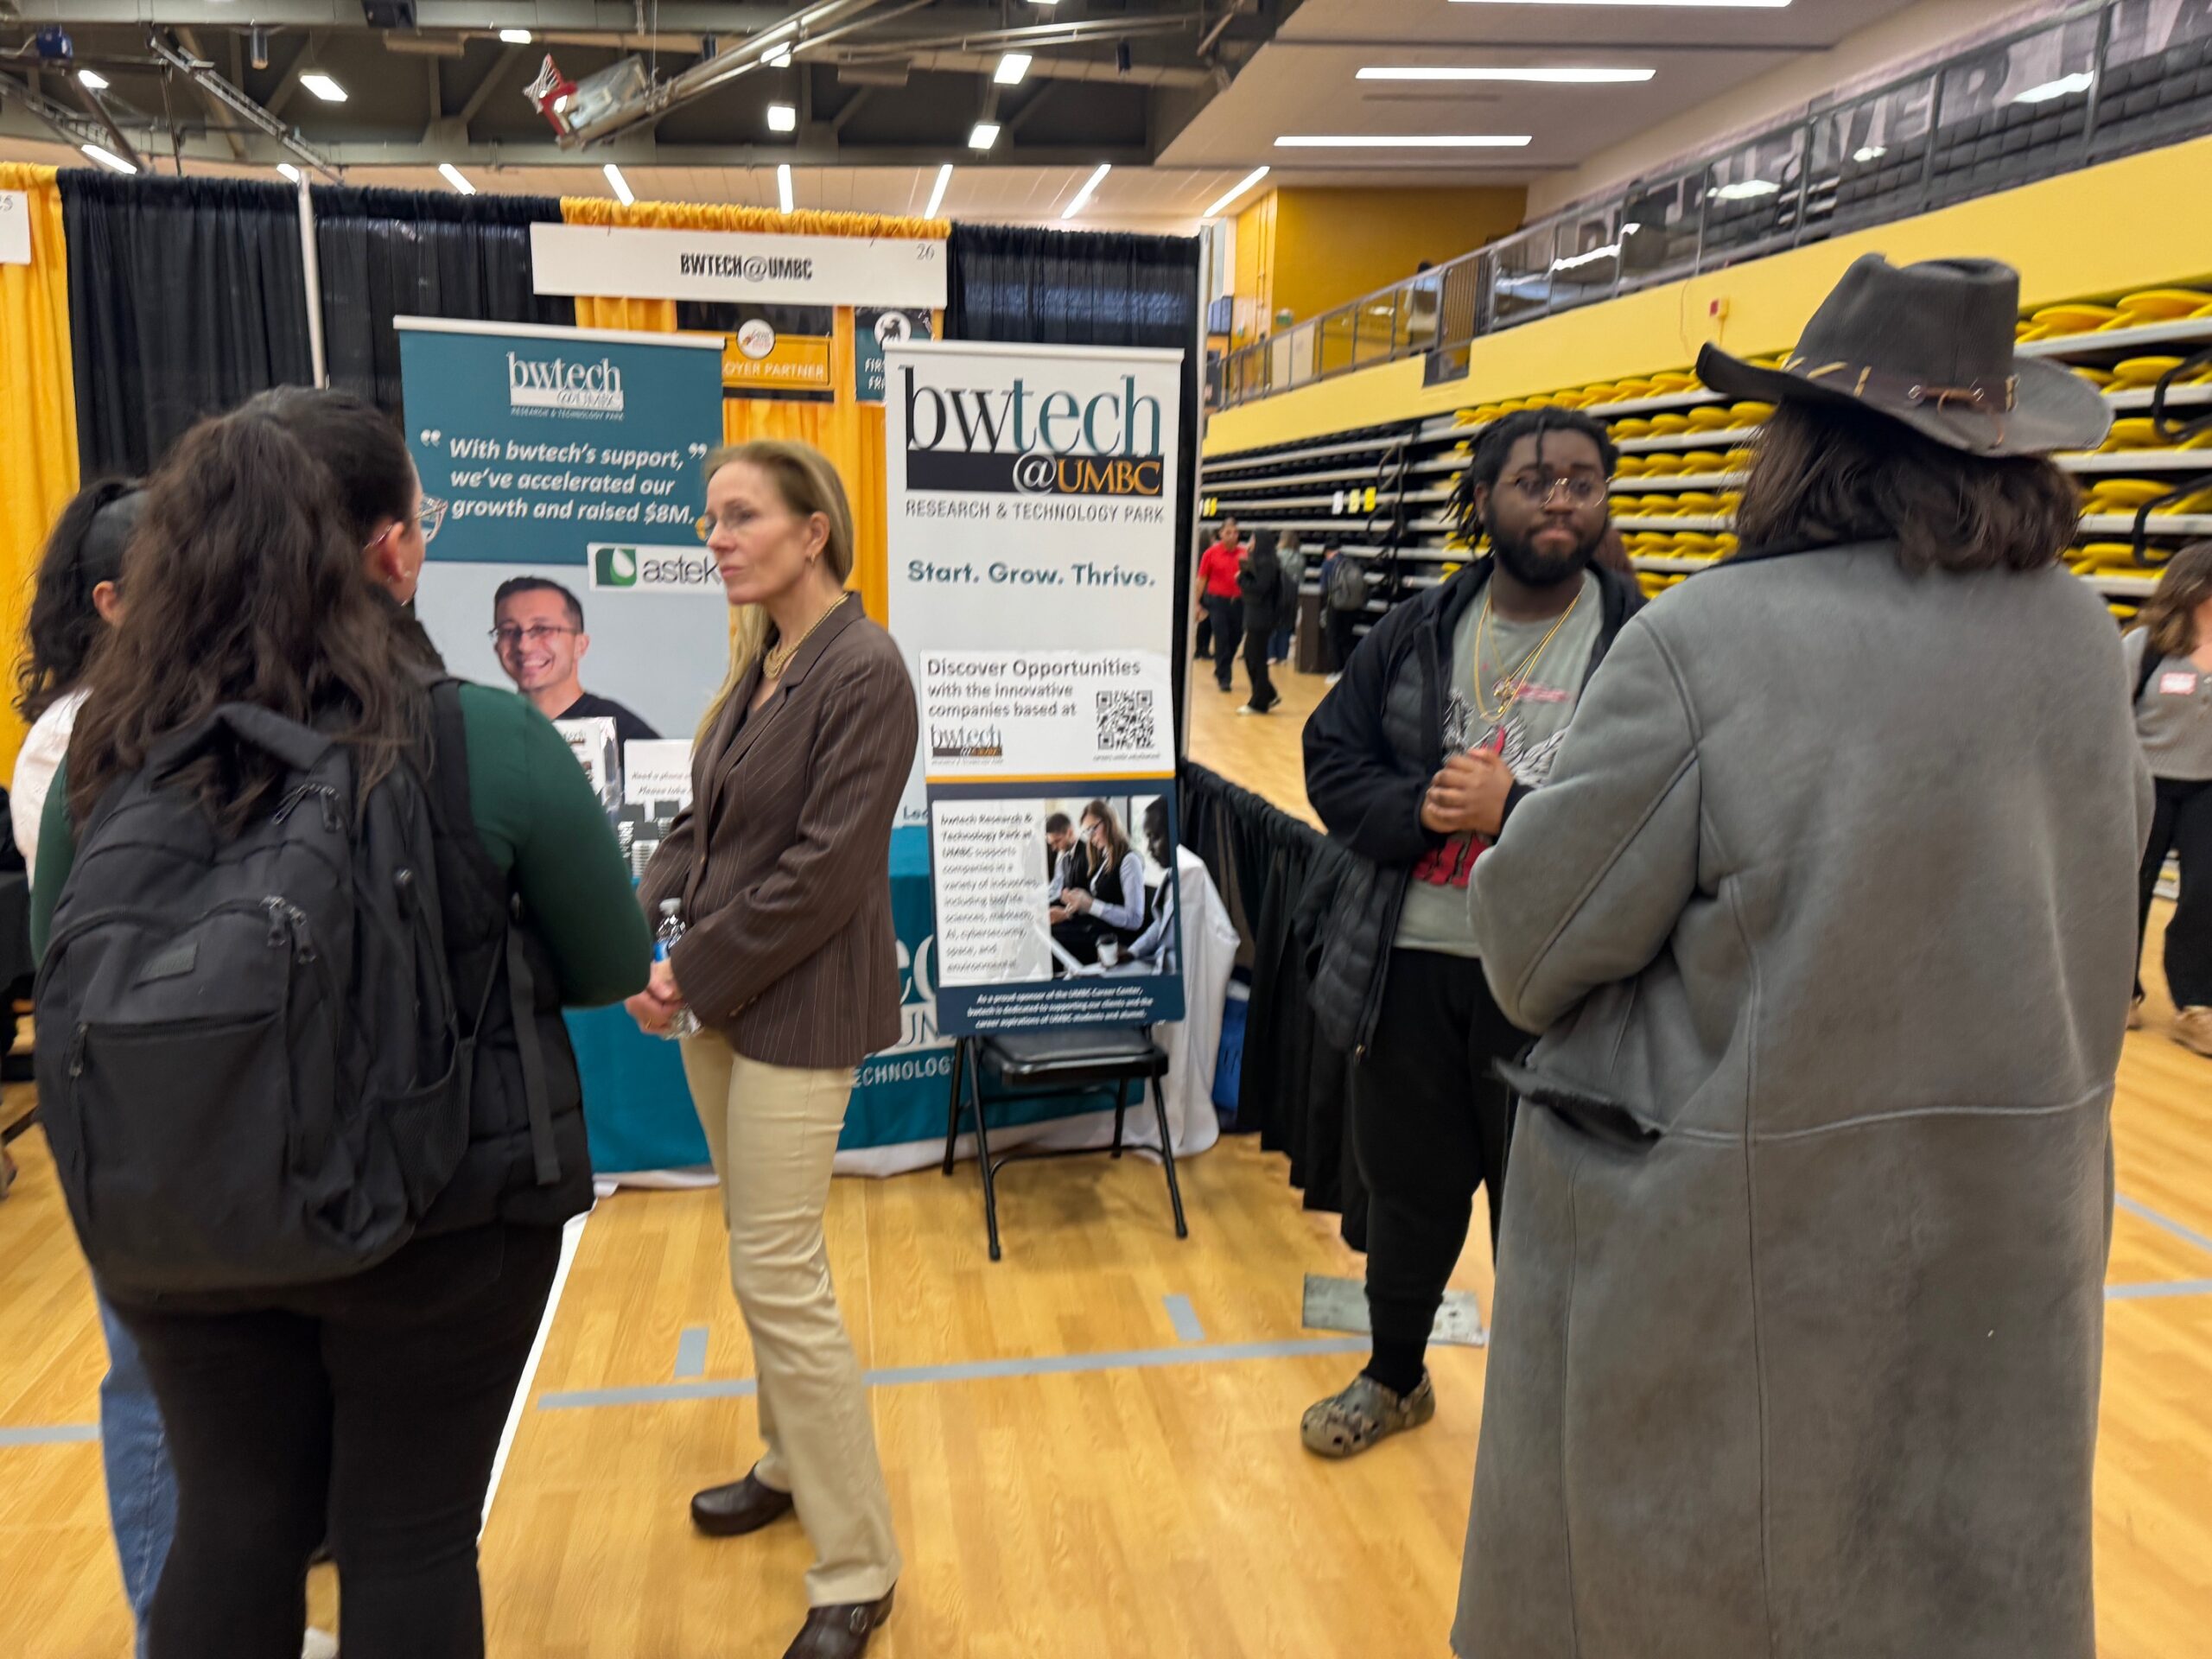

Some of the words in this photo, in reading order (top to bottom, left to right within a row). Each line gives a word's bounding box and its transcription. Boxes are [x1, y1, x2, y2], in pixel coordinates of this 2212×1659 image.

[916, 243, 935, 261] 26
[680, 252, 813, 283] BWTECH@UMBC
[506, 351, 622, 394] bwtech
[764, 361, 824, 379] PARTNER
[899, 364, 1164, 456] bwtech
[449, 437, 501, 460] With
[505, 439, 597, 464] bwtech's
[450, 467, 513, 489] we've
[517, 470, 637, 494] accelerated
[639, 479, 676, 496] our
[1013, 454, 1161, 497] @UMBC
[451, 497, 529, 520] growth
[532, 499, 575, 519] and
[577, 500, 641, 523] raised
[906, 499, 990, 519] RESEARCH
[996, 501, 1007, 519] &
[1012, 501, 1119, 523] TECHNOLOGY
[1123, 505, 1165, 524] PARK
[643, 554, 722, 586] astek
[907, 559, 980, 583] Start.
[988, 561, 1065, 584] Grow.
[1071, 561, 1156, 588] Thrive.
[927, 658, 1007, 677] Discover
[1013, 657, 1141, 681] Opportunities
[927, 681, 962, 698] with
[966, 681, 992, 698] the
[995, 682, 1074, 698] innovative
[928, 701, 1010, 721] companies
[1014, 701, 1058, 717] based
[1061, 702, 1077, 717] at
[931, 723, 1002, 747] bwtech
